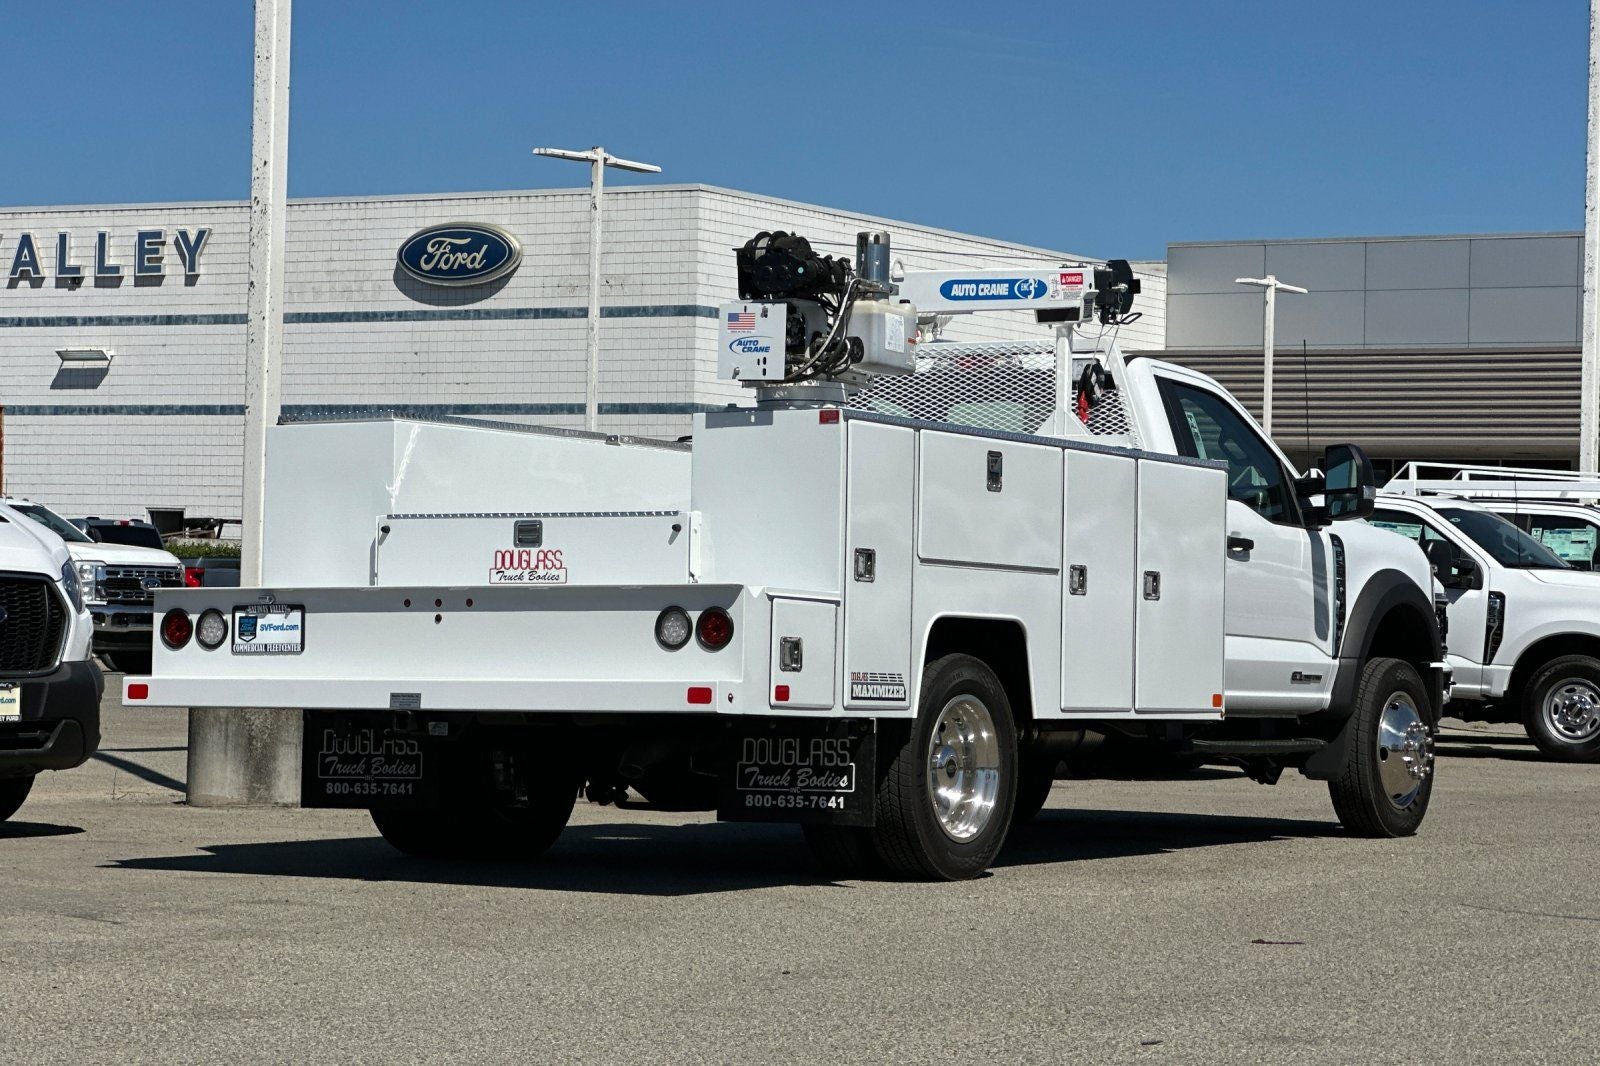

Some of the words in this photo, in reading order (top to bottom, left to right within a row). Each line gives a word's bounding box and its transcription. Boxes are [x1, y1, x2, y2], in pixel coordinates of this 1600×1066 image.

[0, 228, 210, 278] ALLEY
[420, 237, 488, 271] Ford
[951, 283, 975, 296] AUTO
[978, 283, 1009, 296] CRANE
[494, 549, 563, 571] DOUGLASS
[495, 570, 525, 582] Truck
[527, 570, 560, 581] Bodies
[259, 623, 299, 631] SVFord.com
[233, 644, 266, 652] COMMERCIAL
[852, 684, 905, 699] MAXIMIZER
[742, 738, 850, 766] DOUGLASS
[325, 756, 366, 775] Truck
[370, 757, 417, 775] Bodies
[744, 766, 791, 787] Truck
[796, 767, 849, 788] Bodies
[326, 782, 413, 795] 800-635-7641
[745, 795, 845, 809] 800-635-7641
